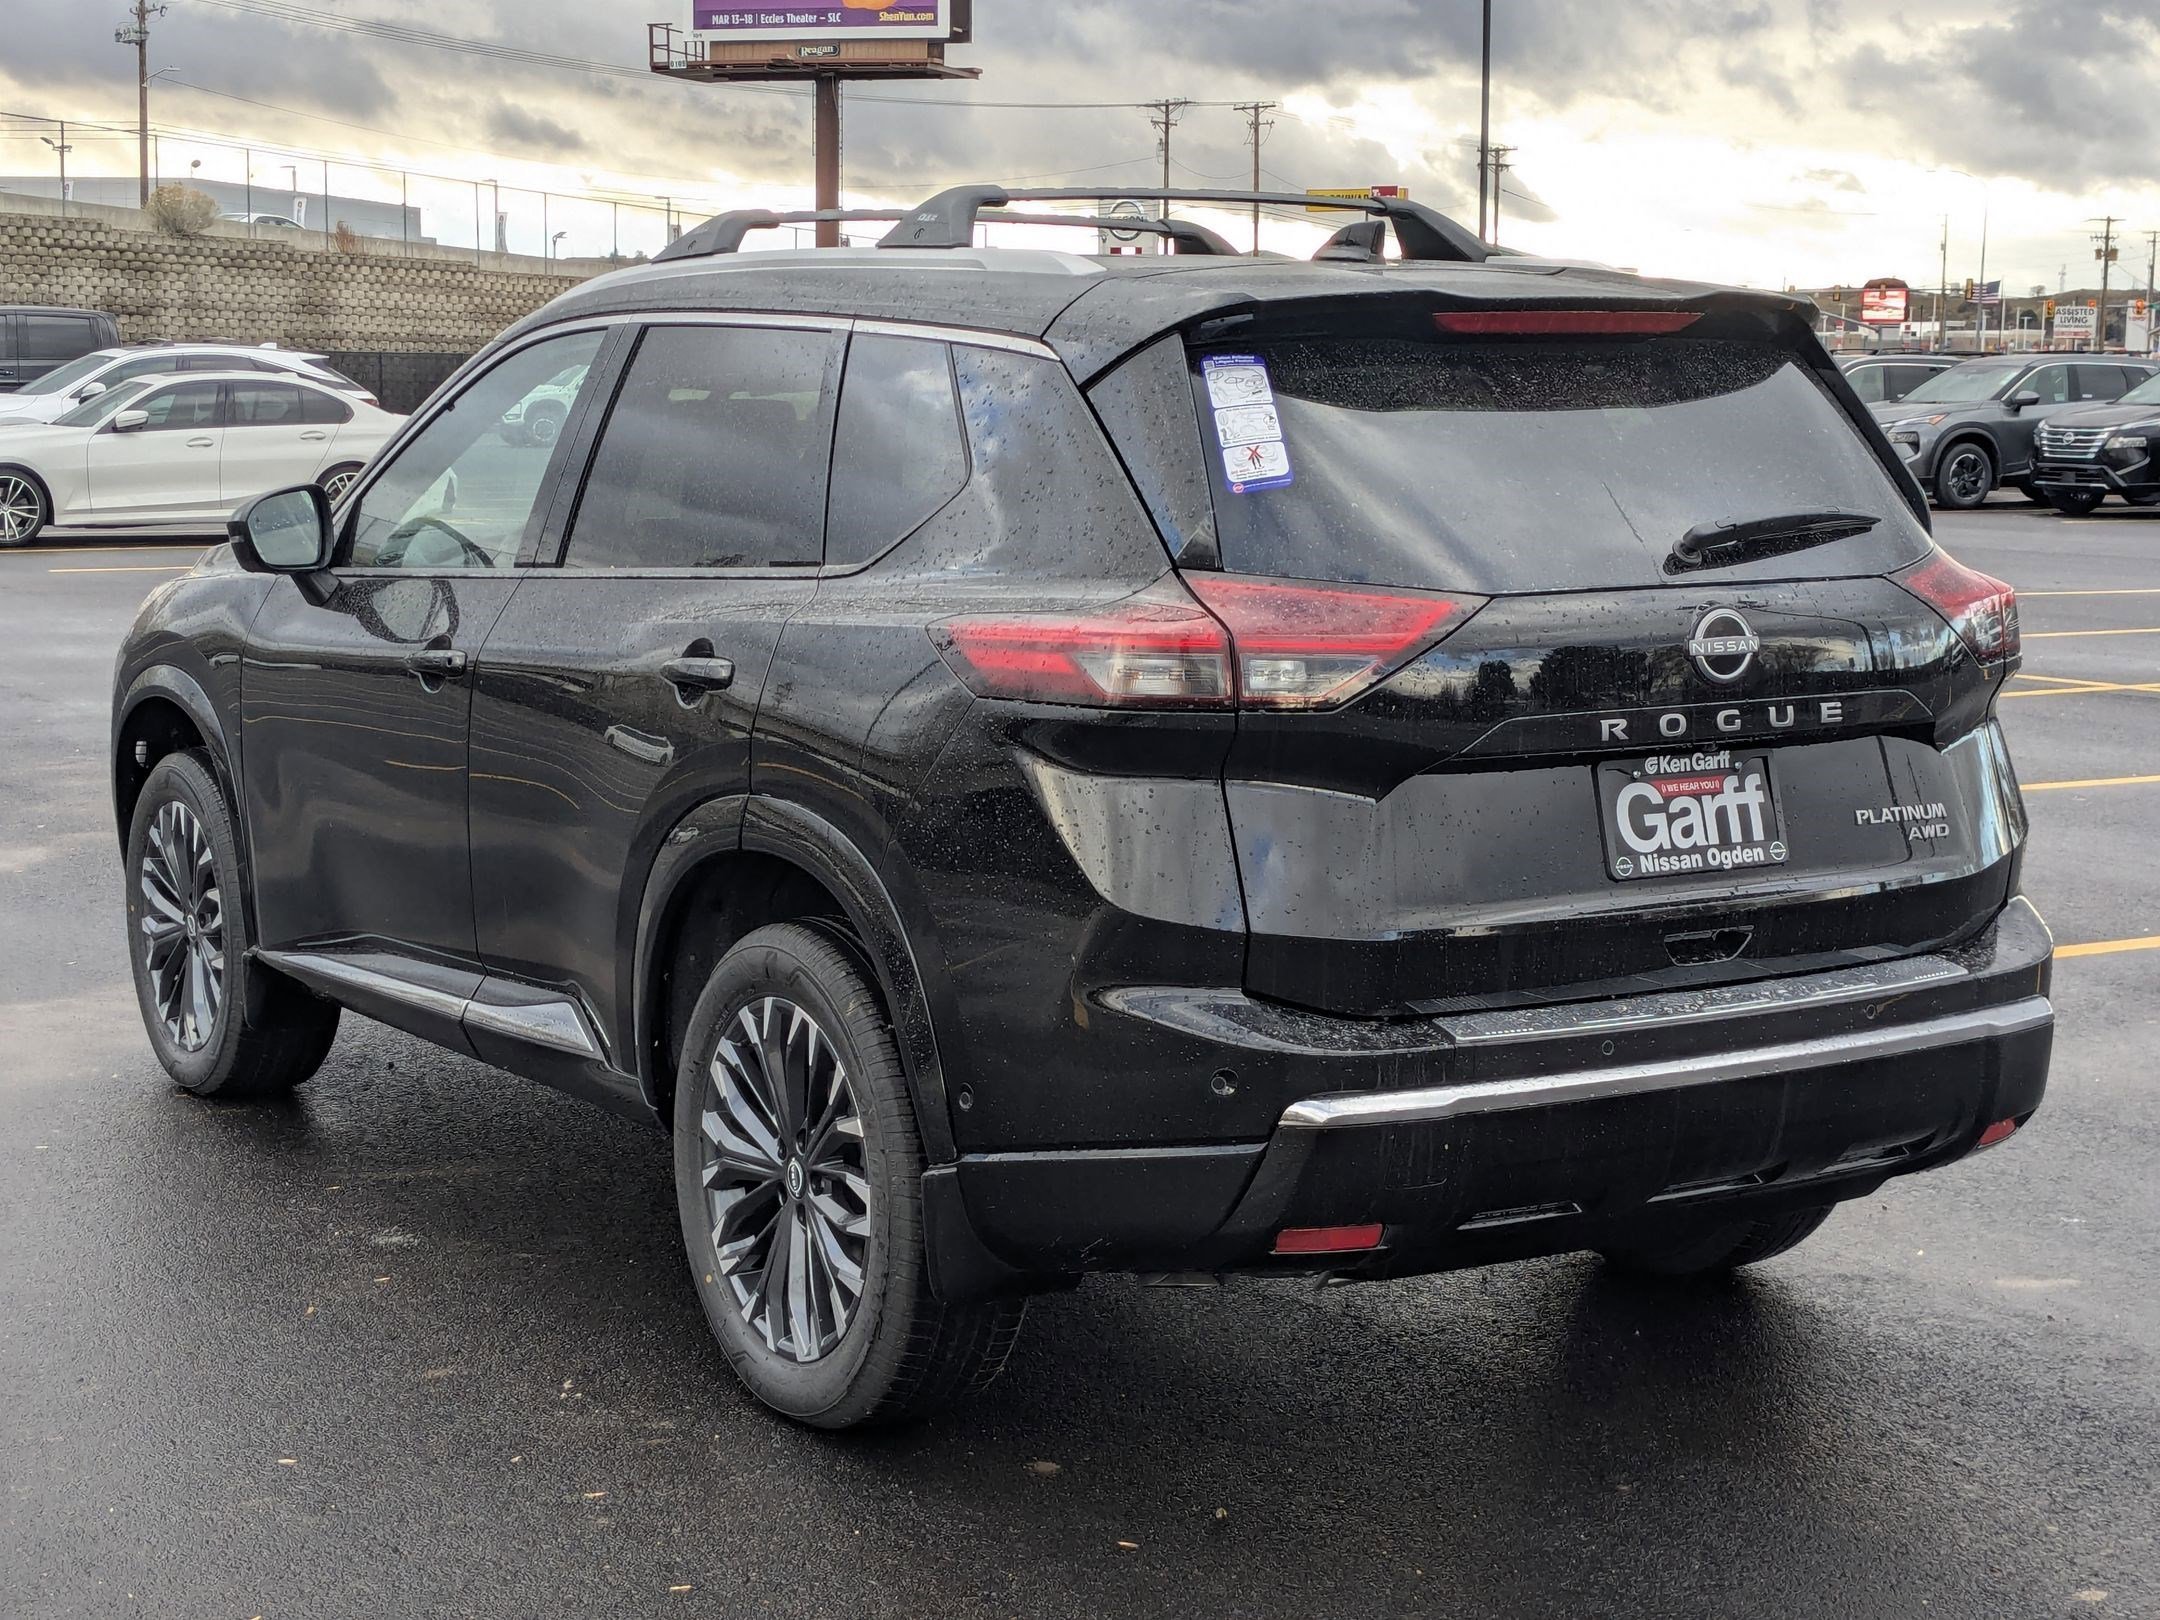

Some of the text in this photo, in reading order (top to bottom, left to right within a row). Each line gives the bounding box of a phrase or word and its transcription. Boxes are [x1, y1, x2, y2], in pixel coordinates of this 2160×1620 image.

[712, 14, 729, 25] MAR
[760, 13, 784, 24] Eccles
[786, 13, 817, 24] Theater
[827, 12, 842, 23] SLC
[800, 46, 833, 57] Reagan
[2056, 308, 2095, 316] ASSISTED
[2060, 316, 2088, 324] LIVING
[1691, 639, 1759, 654] NISSAN
[1600, 701, 1843, 741] ROGUE
[1667, 780, 1715, 792] WE HEAR YOU
[1616, 773, 1765, 853] Garff
[1855, 802, 1947, 825] PLATINUM
[1908, 823, 1950, 840] AWD
[1639, 845, 1765, 874] Nissan Ogden
